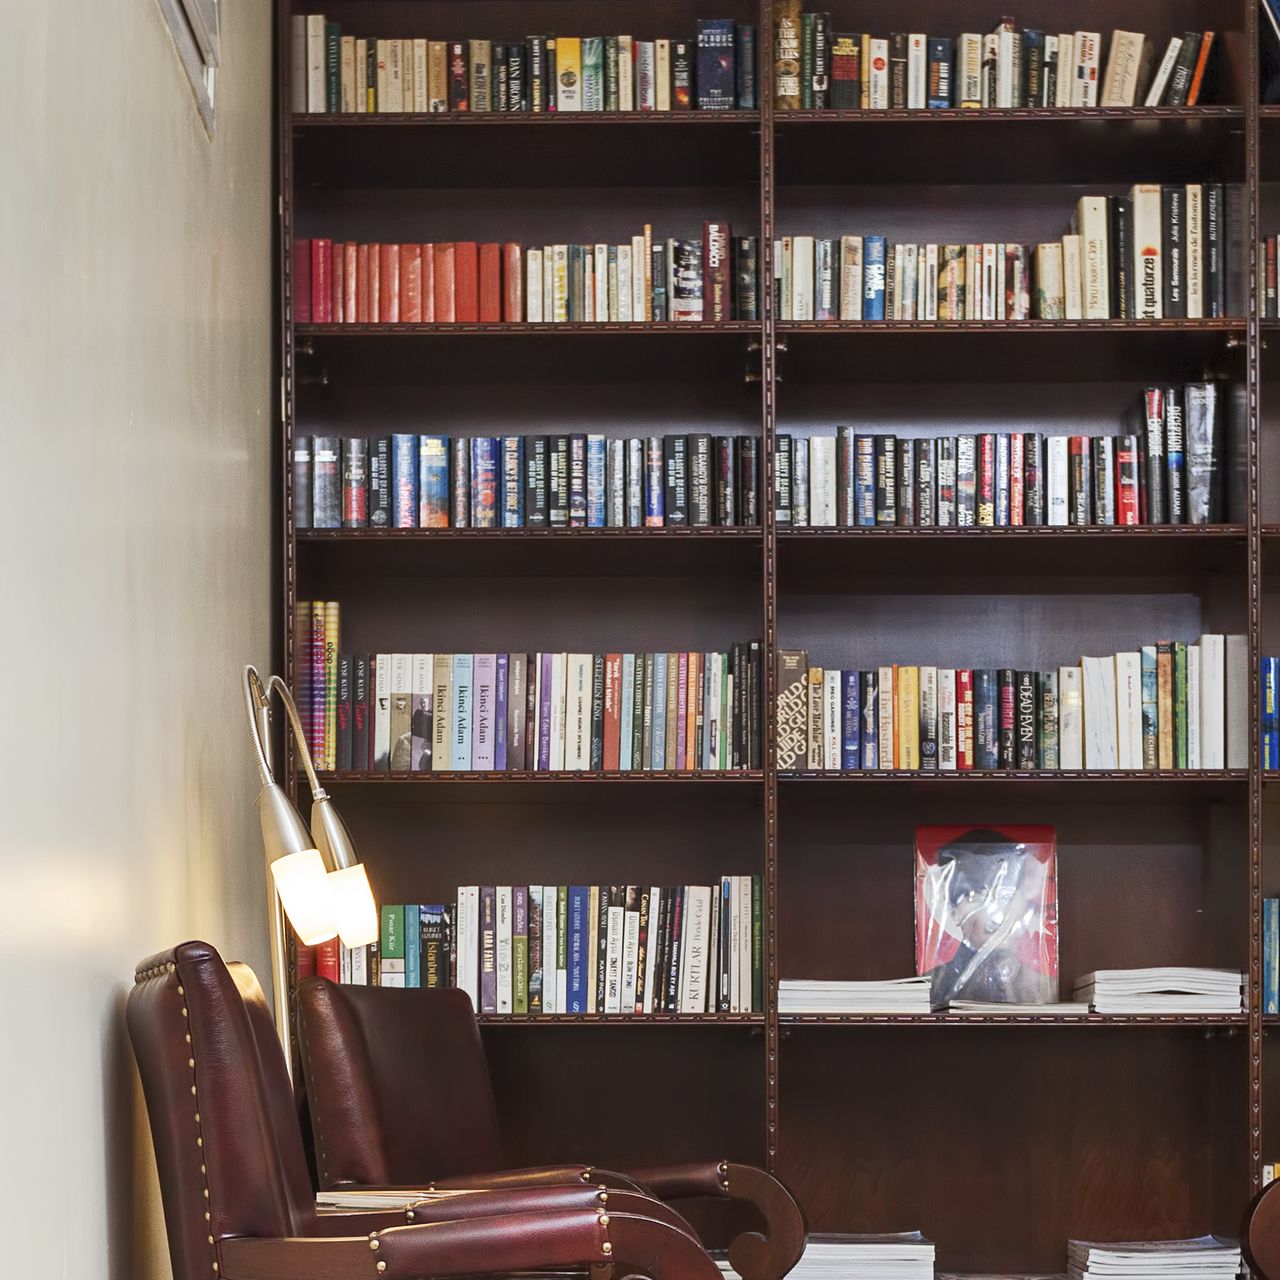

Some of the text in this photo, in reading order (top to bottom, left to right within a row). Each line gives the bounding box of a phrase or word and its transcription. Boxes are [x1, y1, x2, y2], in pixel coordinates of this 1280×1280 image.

[510, 58, 521, 112] DAN BROWN
[709, 224, 719, 268] BALDACCI
[1141, 258, 1157, 308] quatorze
[1170, 288, 1180, 302] Les
[534, 440, 544, 453] TOM
[558, 439, 567, 451] TOM
[675, 440, 684, 452] TOM
[1167, 406, 1182, 452] DECEPTION
[698, 438, 708, 484] TOM CLANCY'S
[958, 438, 967, 476] ARCHER
[326, 642, 335, 664] doğa
[634, 658, 642, 684] AGATHA
[593, 658, 602, 720] STEPHEN KING
[812, 683, 822, 695] The
[812, 696, 822, 712] Love
[436, 684, 447, 744] İkinci Adam
[457, 684, 468, 744] İkinci Adam
[478, 684, 490, 744] İkinci Adam
[1020, 686, 1033, 742] DEAD EVEN
[942, 746, 953, 763] Doubt
[516, 892, 524, 906] can
[640, 894, 648, 914] CANAN
[387, 934, 396, 951] Kür
[483, 930, 493, 973] KARA FATMA
[689, 946, 702, 1000] KURTLAR
